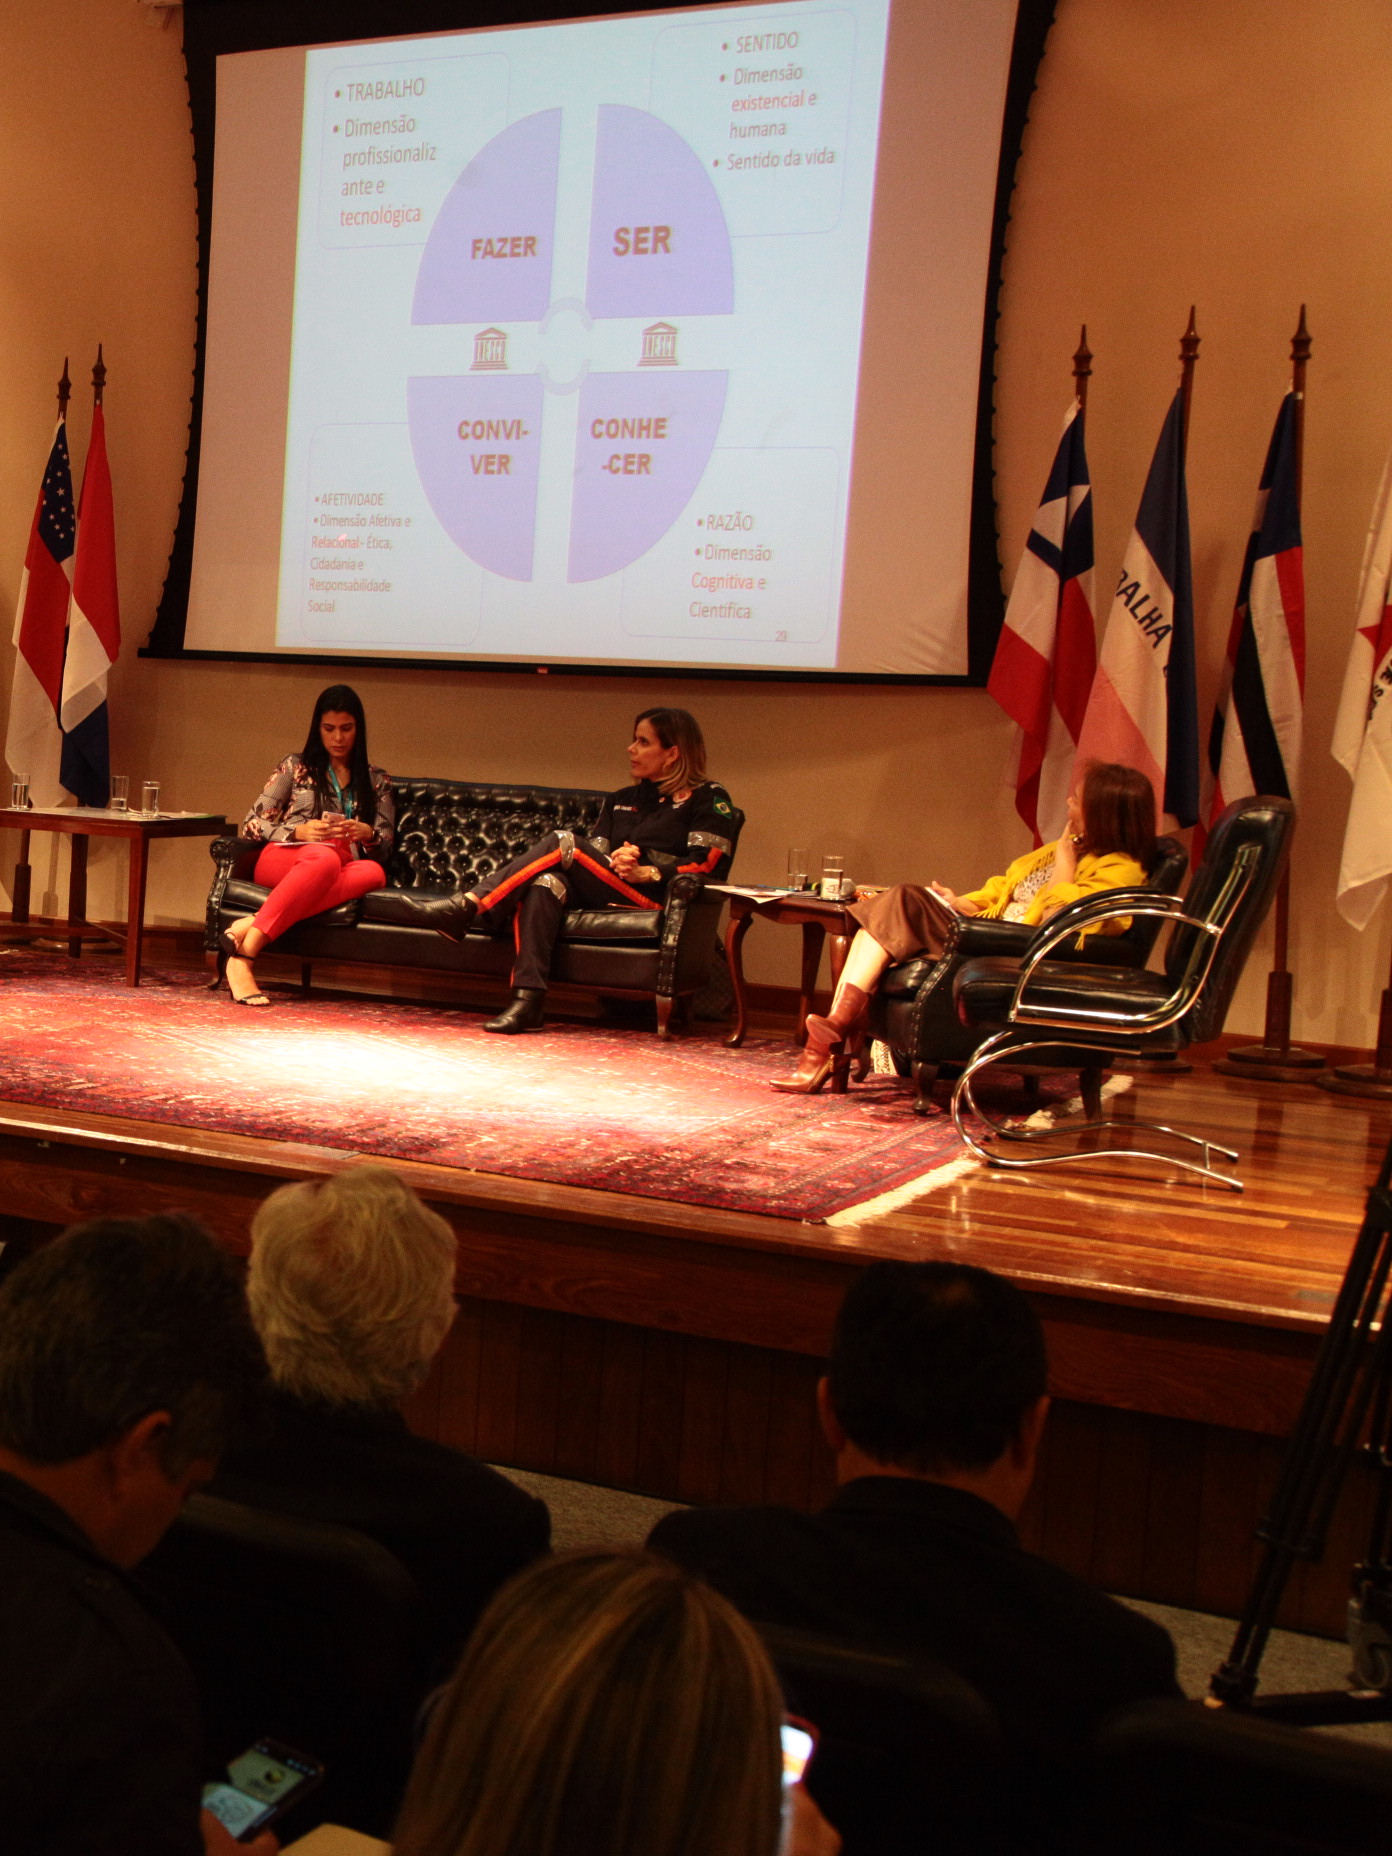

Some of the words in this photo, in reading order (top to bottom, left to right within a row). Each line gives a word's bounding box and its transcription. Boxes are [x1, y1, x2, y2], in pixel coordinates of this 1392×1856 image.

[736, 31, 799, 53] SENTIDO
[734, 63, 803, 85] Dimensão
[346, 77, 425, 102] TRABALHO
[731, 89, 805, 112] existencial
[808, 93, 817, 106] e
[344, 114, 416, 137] Dimensão
[729, 122, 786, 139] humana
[342, 142, 437, 171] profissionaliz
[727, 151, 780, 171] Sentido
[783, 149, 801, 167] da
[805, 147, 836, 165] vida
[341, 179, 373, 196] ante
[376, 179, 385, 194] e
[339, 204, 422, 228] tecnológica
[470, 236, 538, 260] FAZER
[612, 225, 672, 257] SER
[457, 418, 530, 441] CONVI-
[590, 417, 669, 440] CONHE
[470, 454, 511, 475] VER
[601, 453, 652, 475] -CER
[320, 493, 385, 506] AFETIVIDADE
[319, 513, 366, 527] Dimensão
[368, 513, 402, 528] Afetiva
[404, 517, 411, 527] e
[706, 511, 753, 531] RAZÃO
[309, 557, 356, 570] Cidadania
[357, 560, 364, 570] e
[704, 544, 772, 561] Dimensão
[308, 578, 392, 593] Responsabilidade
[691, 571, 754, 593] Cognitiva
[757, 577, 766, 590] e
[307, 600, 335, 613] Social
